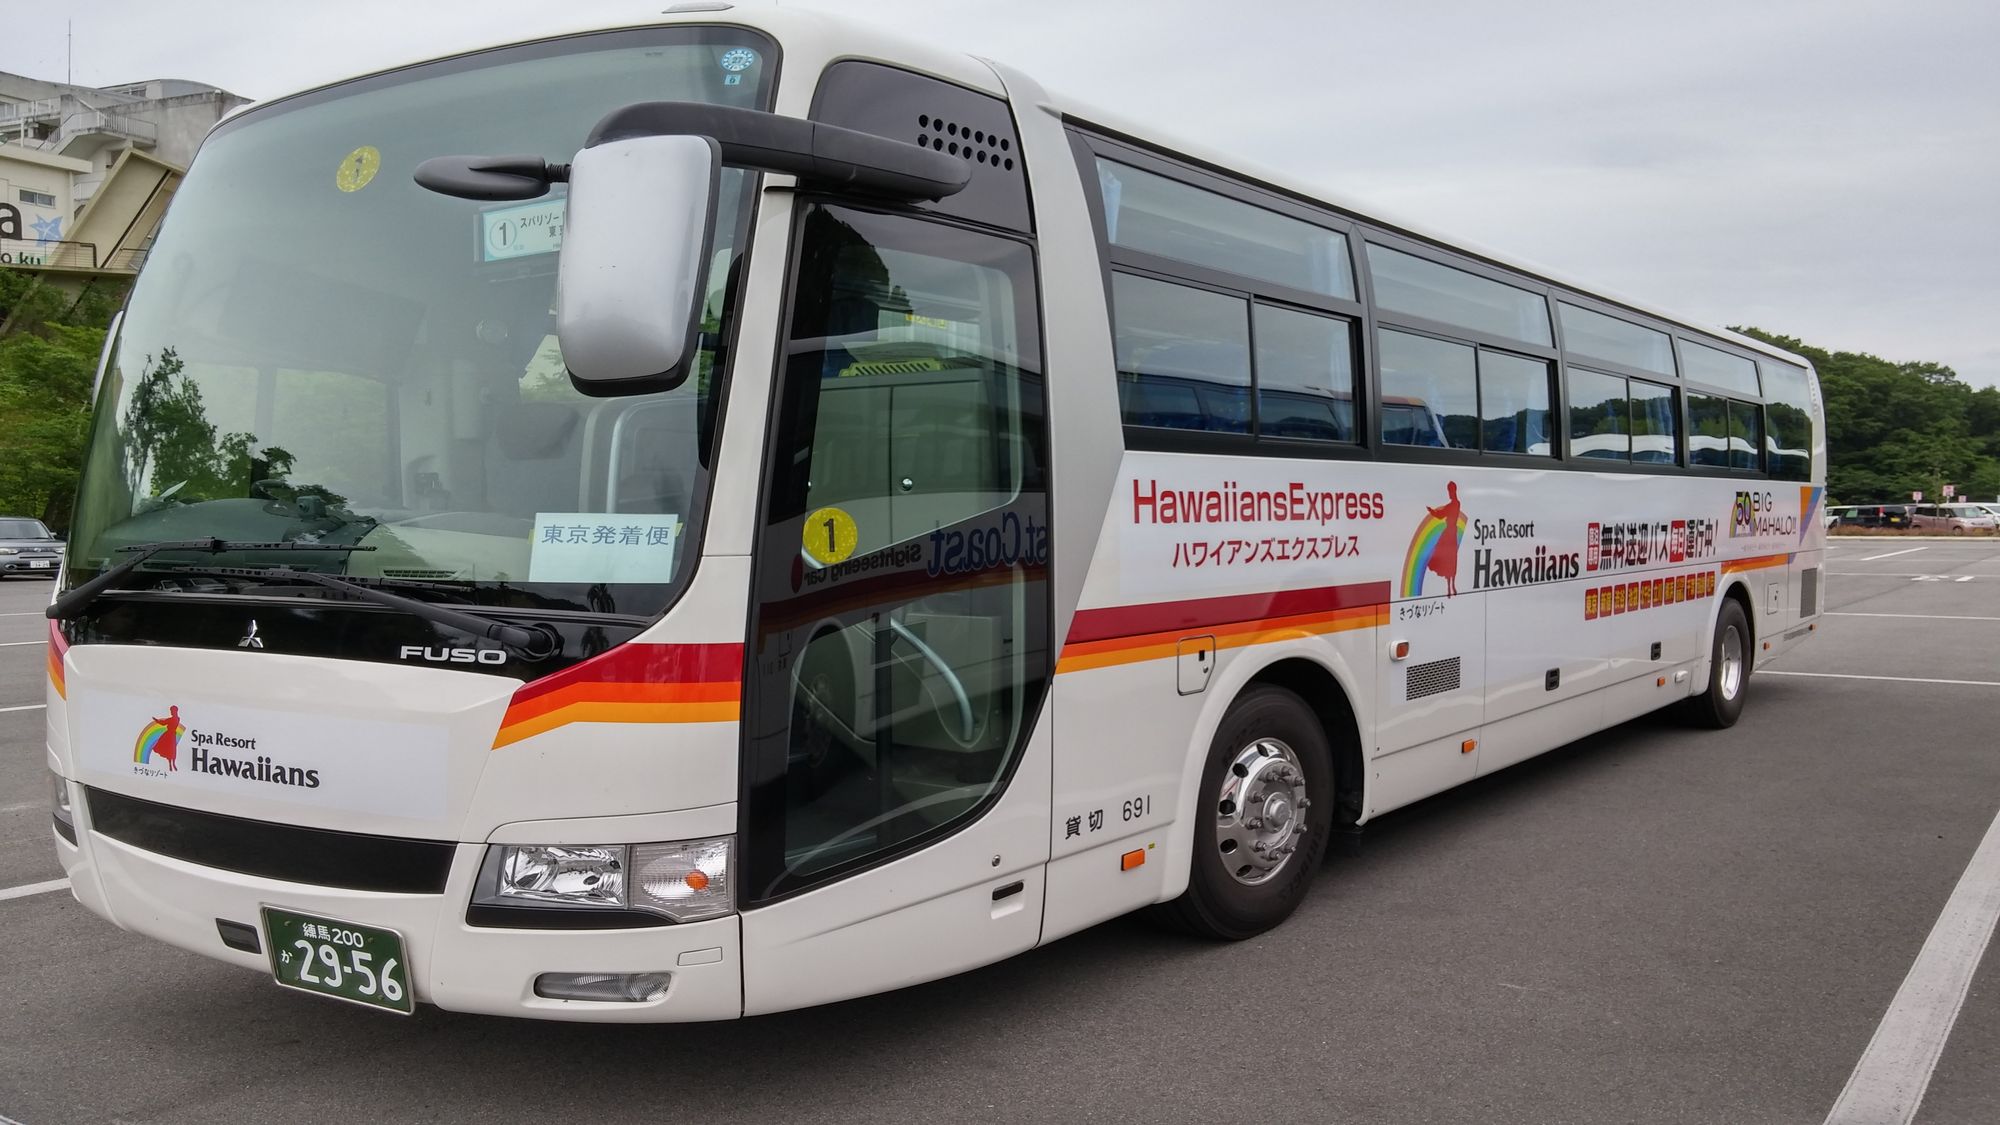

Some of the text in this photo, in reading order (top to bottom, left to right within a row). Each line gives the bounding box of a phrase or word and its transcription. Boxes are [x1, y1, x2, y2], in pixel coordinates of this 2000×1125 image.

[1133, 479, 1384, 526] HawaiiansExpress
[1753, 491, 1772, 512] BIG
[541, 524, 670, 546] 東京発着便
[823, 518, 835, 553] 1
[1473, 518, 1534, 545] Spa Resort
[1172, 535, 1360, 568] ハワイアンズエクスプレス
[1473, 545, 1579, 589] Hawaiians
[400, 645, 507, 665] FUSO
[191, 729, 256, 750] Spa Resort
[191, 747, 320, 788] Hawaiians
[1122, 794, 1150, 822] 691
[281, 939, 403, 1001] か 29-56
